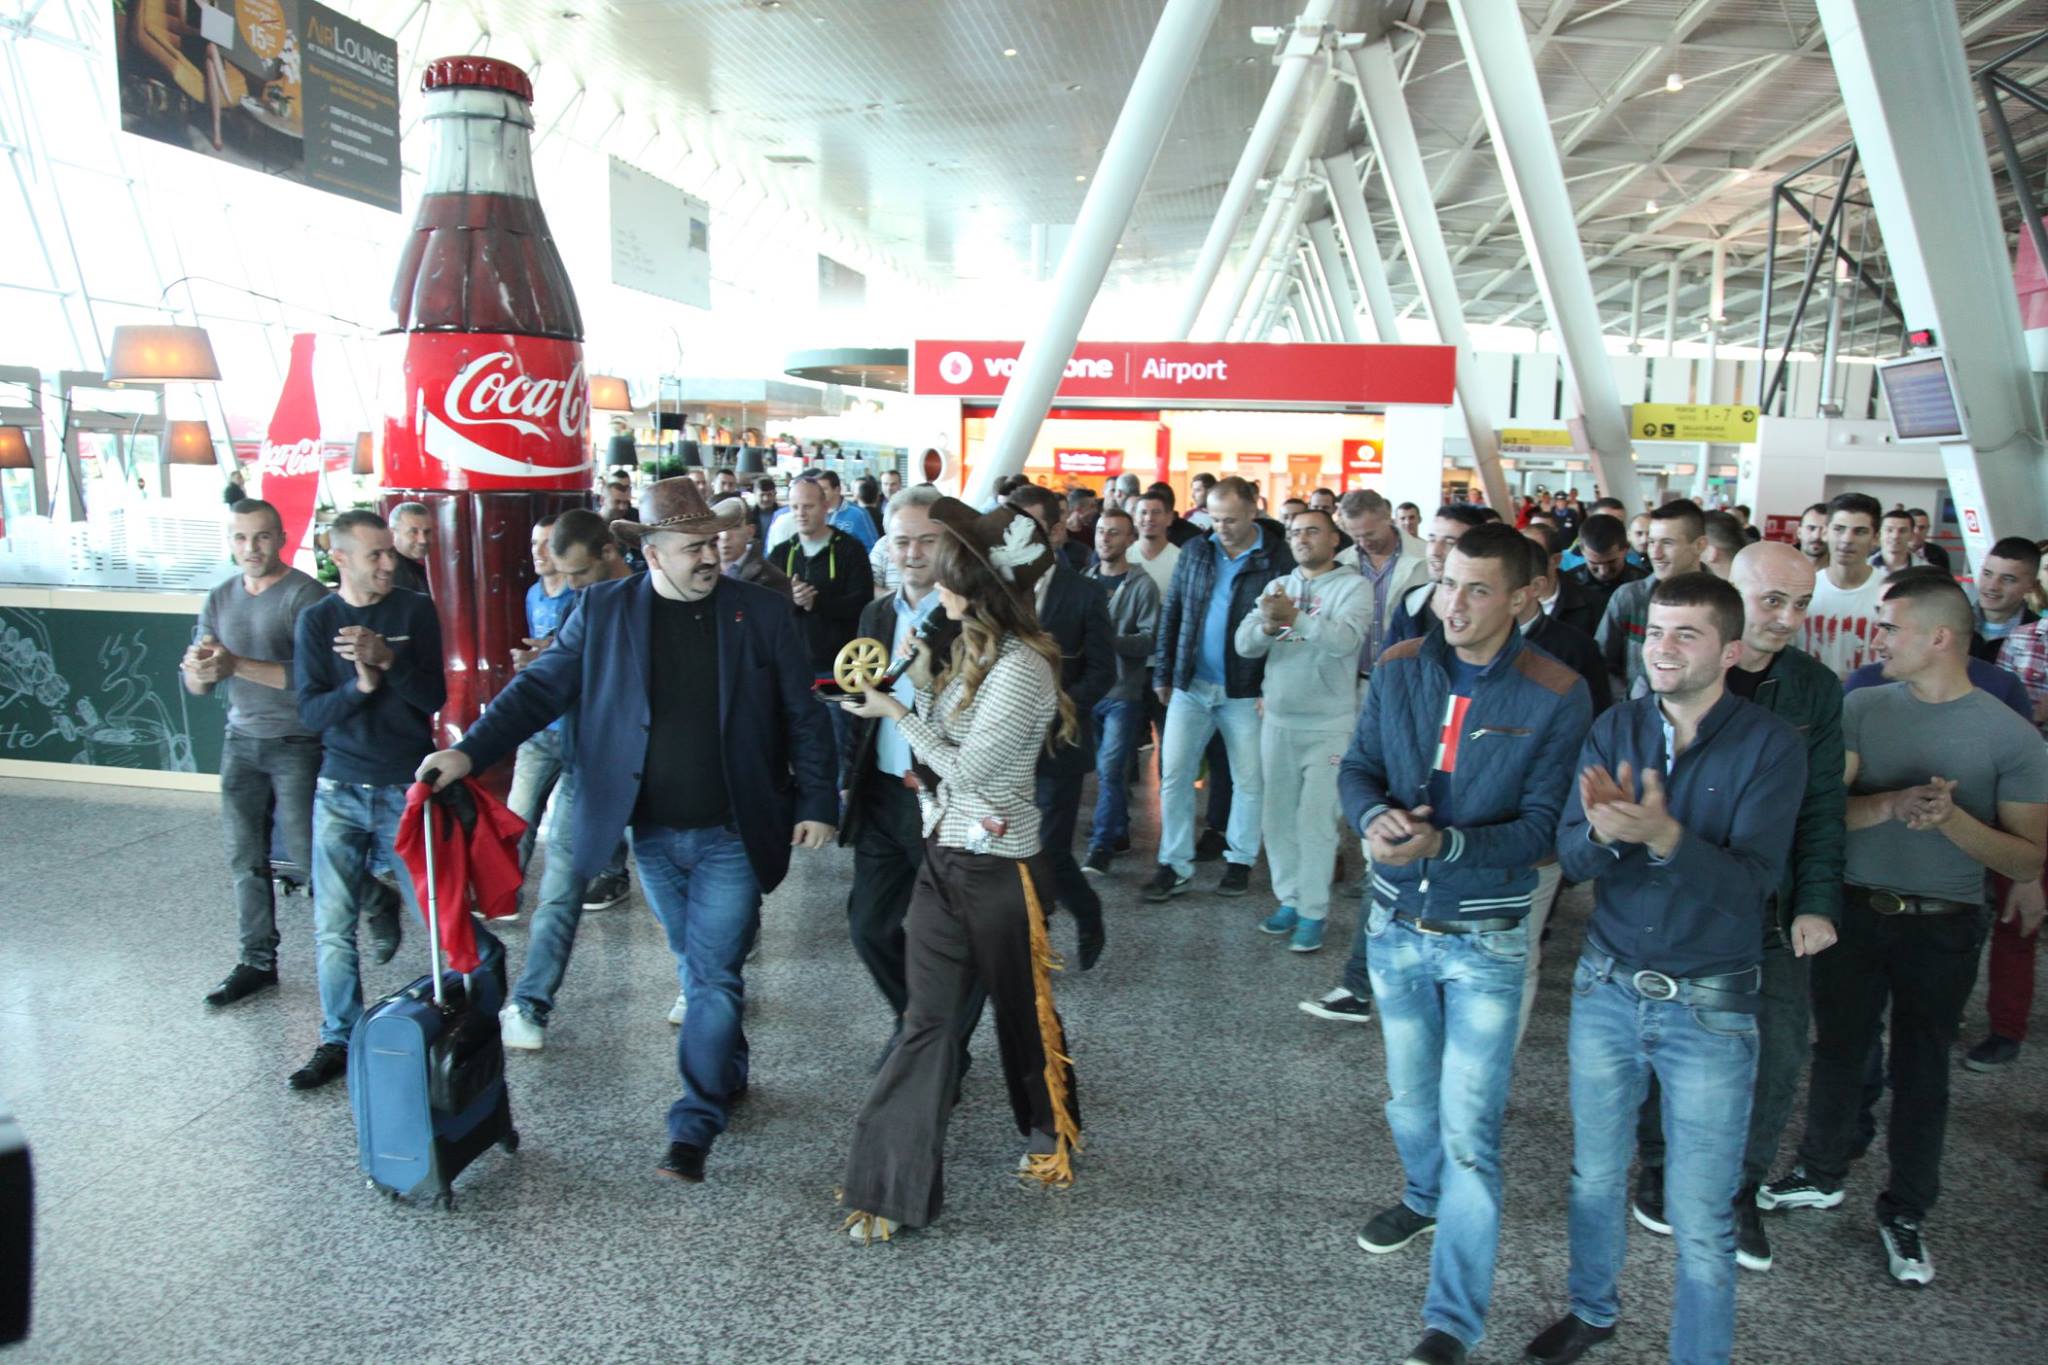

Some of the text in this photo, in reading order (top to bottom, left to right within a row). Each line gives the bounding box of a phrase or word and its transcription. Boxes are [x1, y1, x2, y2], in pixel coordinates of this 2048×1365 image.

[984, 357, 1228, 384] voone Airport
[0, 722, 59, 749] te
